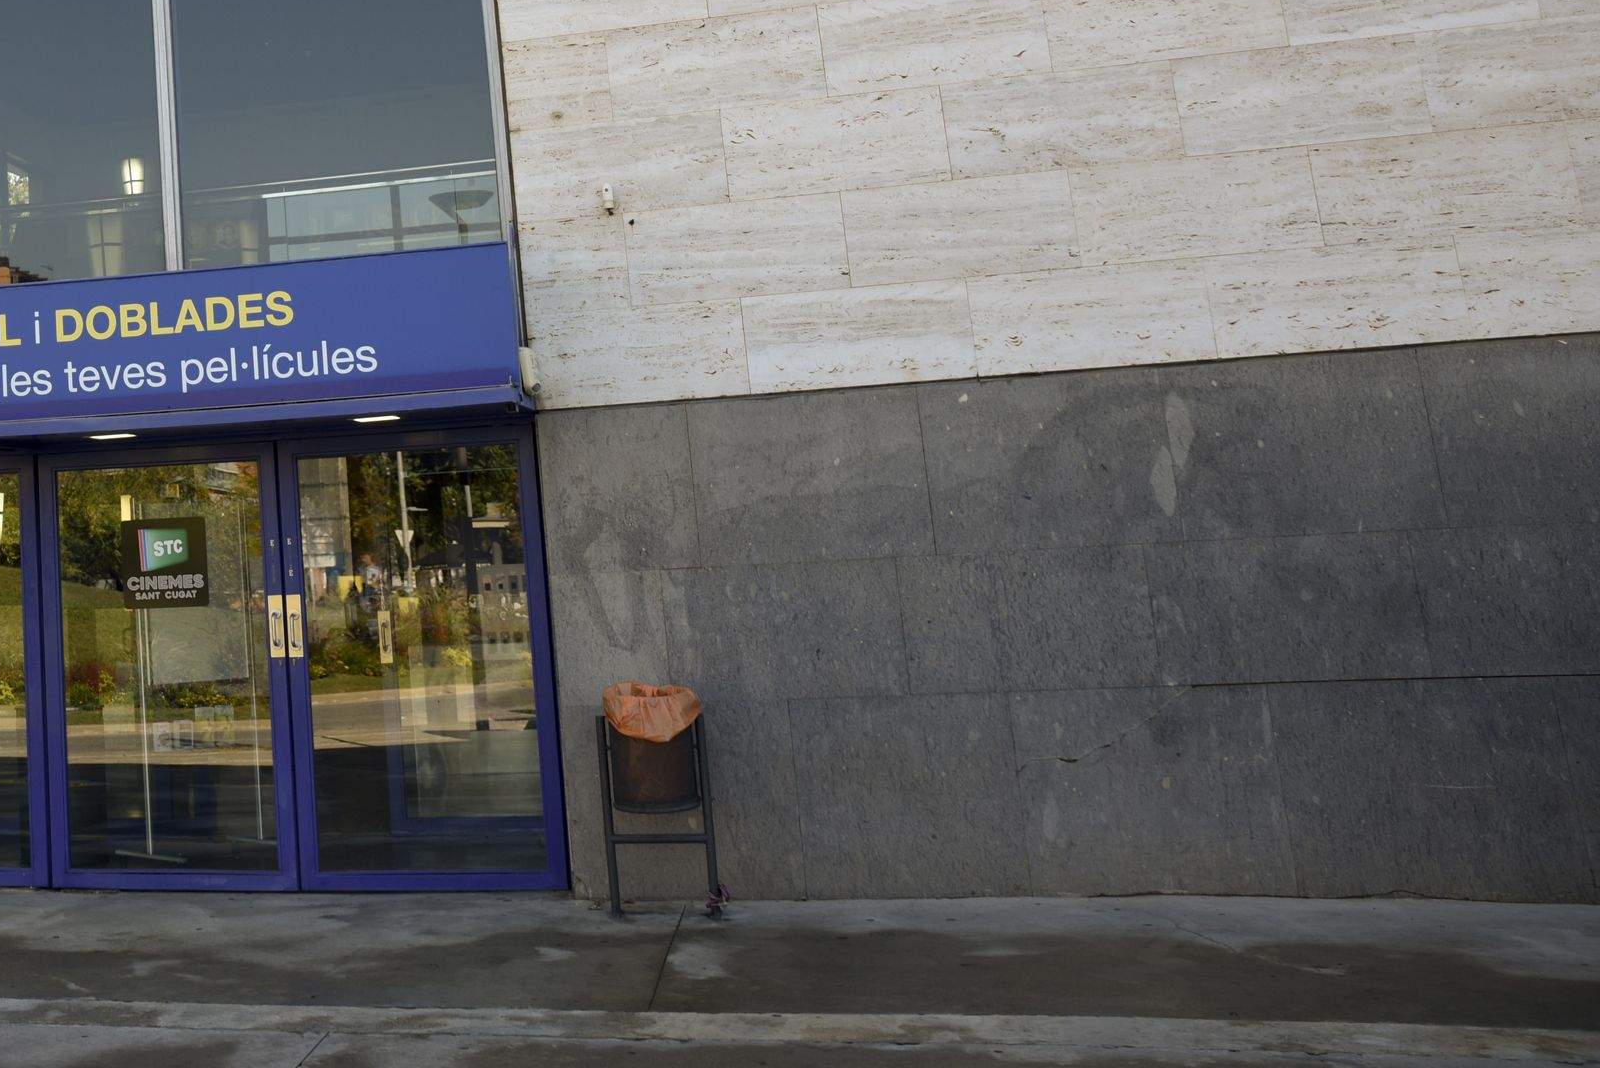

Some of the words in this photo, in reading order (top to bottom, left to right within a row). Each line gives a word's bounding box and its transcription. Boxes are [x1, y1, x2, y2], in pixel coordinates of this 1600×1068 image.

[33, 311, 41, 344] i
[55, 291, 295, 343] DOBLADES
[2, 363, 53, 398] les
[64, 360, 167, 393] teves
[181, 340, 379, 393] pel·lícules
[154, 538, 183, 557] STC
[127, 573, 205, 591] CINEMES
[135, 591, 161, 600] SANT
[164, 590, 197, 599] CUGAT
